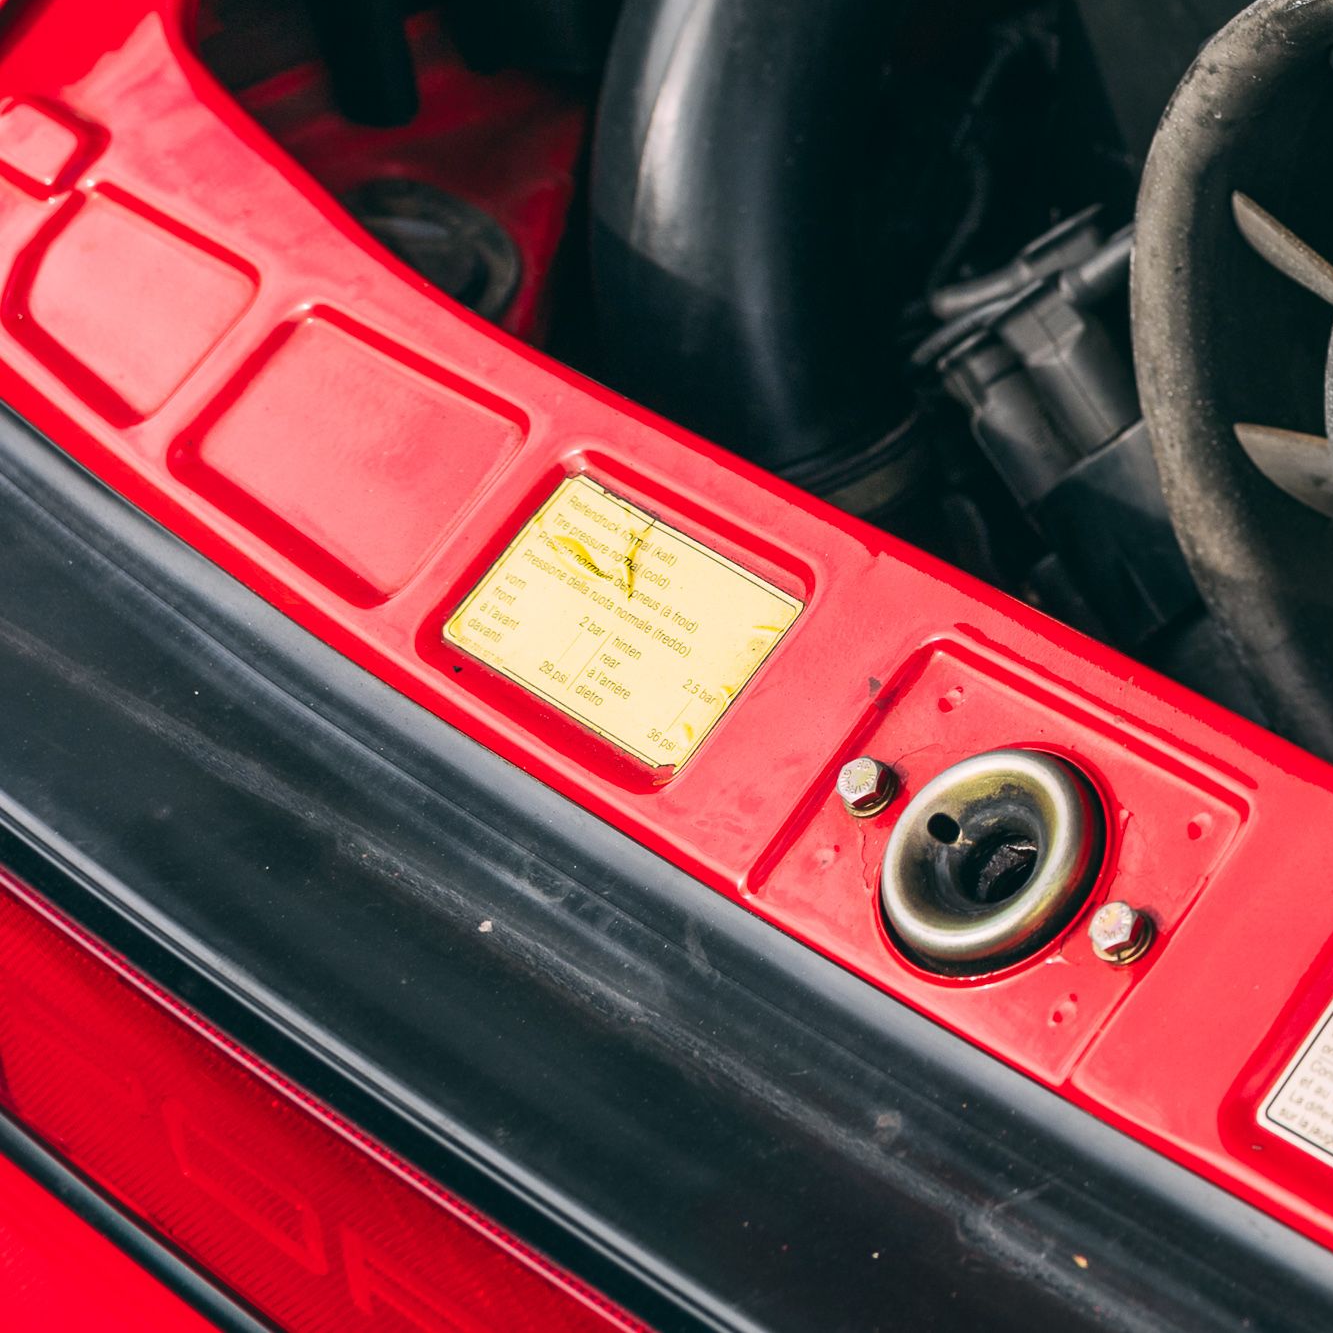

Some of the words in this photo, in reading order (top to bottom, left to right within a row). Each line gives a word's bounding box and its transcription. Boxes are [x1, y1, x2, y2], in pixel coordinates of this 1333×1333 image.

[567, 496, 622, 533] Reifendruck
[650, 545, 679, 568] (kalt)
[551, 513, 573, 530] Tire
[568, 526, 609, 554] pressure
[639, 566, 671, 590] (cold)
[503, 572, 527, 590] vorn
[491, 585, 517, 605] front
[521, 548, 568, 581] Pressione
[566, 574, 591, 594] della
[588, 591, 614, 610] ruota
[613, 604, 654, 633] normale
[650, 627, 693, 658] (freddo)
[487, 606, 520, 630] l'avant
[628, 588, 661, 613] pneus
[669, 610, 700, 635] froid)
[466, 616, 503, 643] davanti
[577, 615, 590, 628] 2
[586, 621, 607, 637] bar
[611, 636, 644, 660] hinten
[598, 652, 621, 669] rear
[538, 660, 555, 675] 29
[549, 668, 570, 686] psi
[574, 682, 605, 706] dietro
[697, 688, 719, 705] bar
[645, 727, 663, 742] 36
[658, 736, 677, 753] psi
[1288, 1090, 1305, 1105] La
[1299, 1075, 1313, 1088] et
[1314, 1084, 1331, 1099] au
[1277, 1108, 1297, 1123] sur
[1297, 1116, 1310, 1129] la
